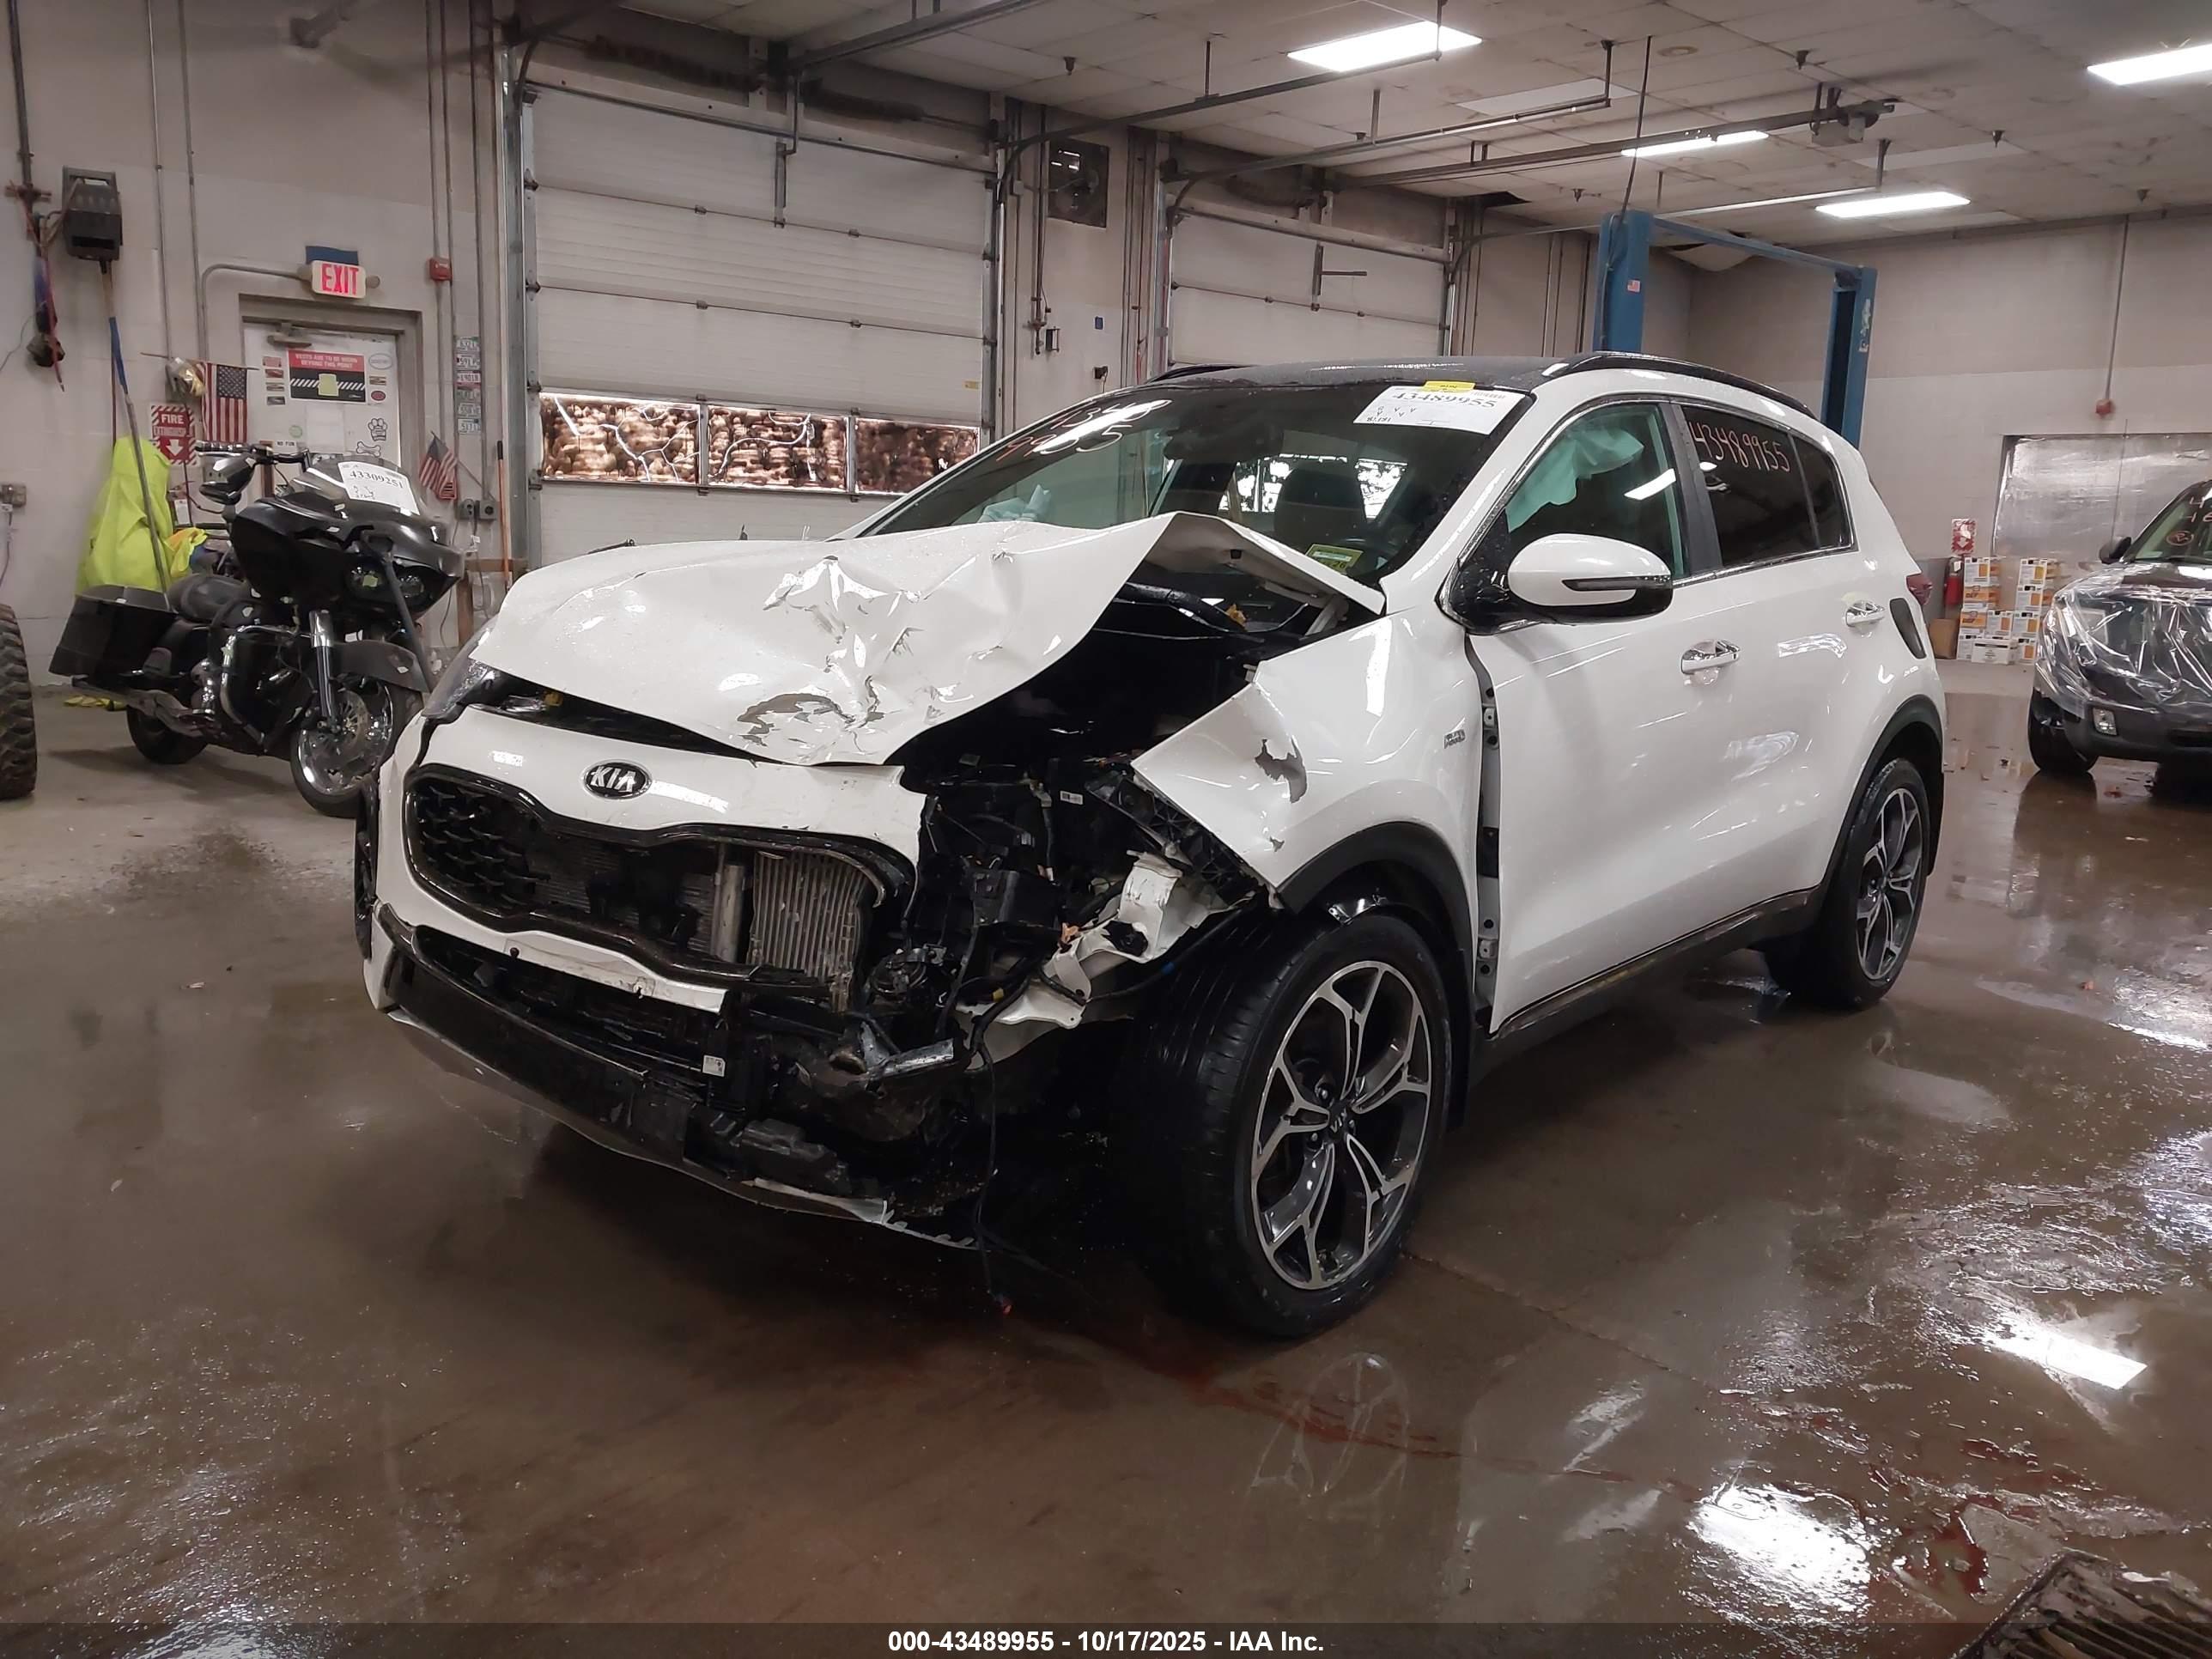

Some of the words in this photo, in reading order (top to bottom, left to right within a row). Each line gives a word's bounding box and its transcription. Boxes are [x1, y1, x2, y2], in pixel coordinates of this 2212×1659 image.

[321, 263, 359, 295] EXIT
[1392, 392, 1498, 409] 43489955
[161, 414, 185, 424] FIRE
[1688, 421, 1791, 472] 43489955
[349, 470, 404, 489] 43309251
[589, 766, 637, 793] KIA
